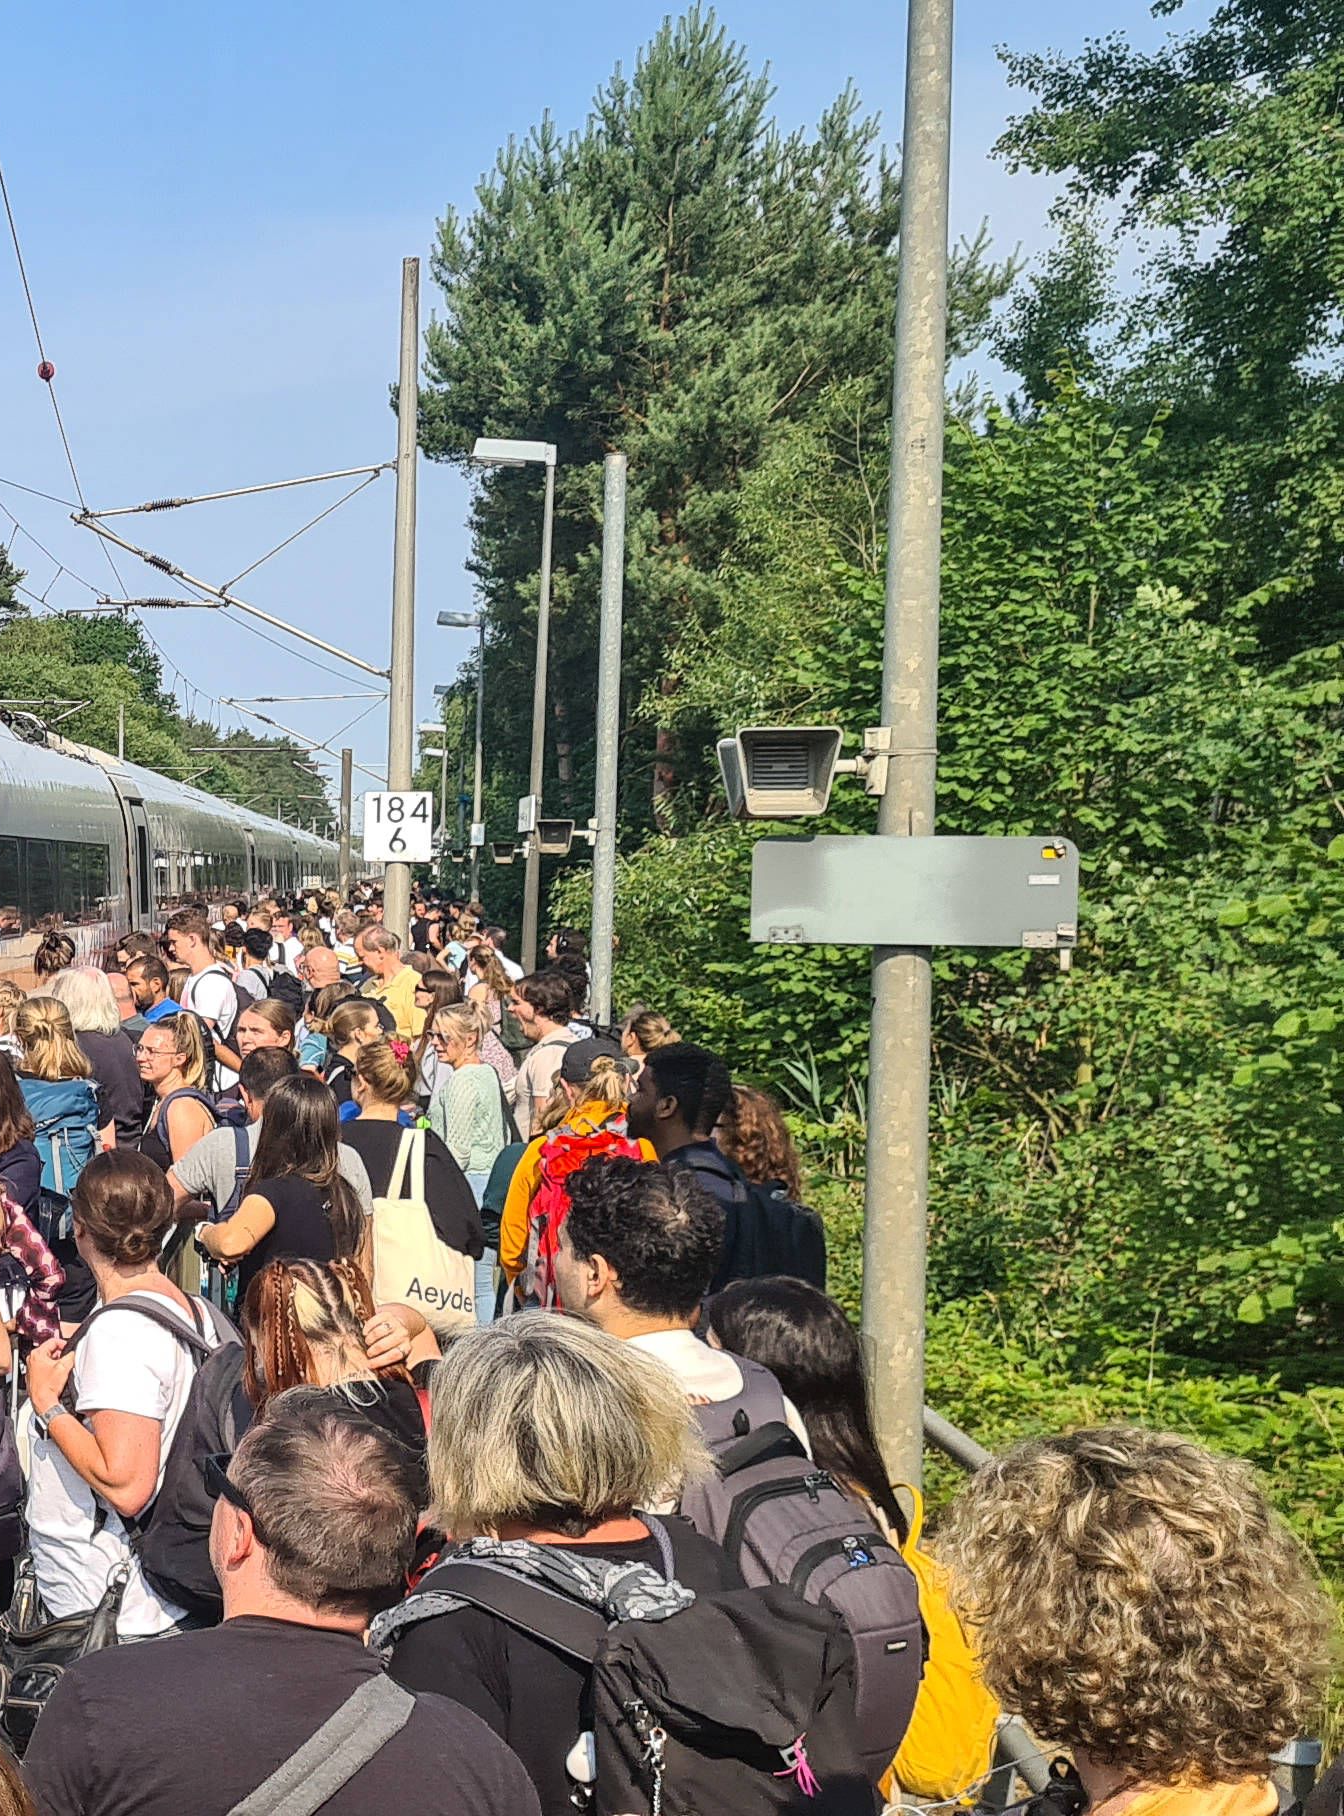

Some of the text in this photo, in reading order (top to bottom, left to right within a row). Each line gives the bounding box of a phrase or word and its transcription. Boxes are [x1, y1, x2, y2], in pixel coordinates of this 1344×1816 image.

[373, 796, 429, 823] 184
[389, 828, 406, 853] 6
[405, 1276, 473, 1313] Aeyde
